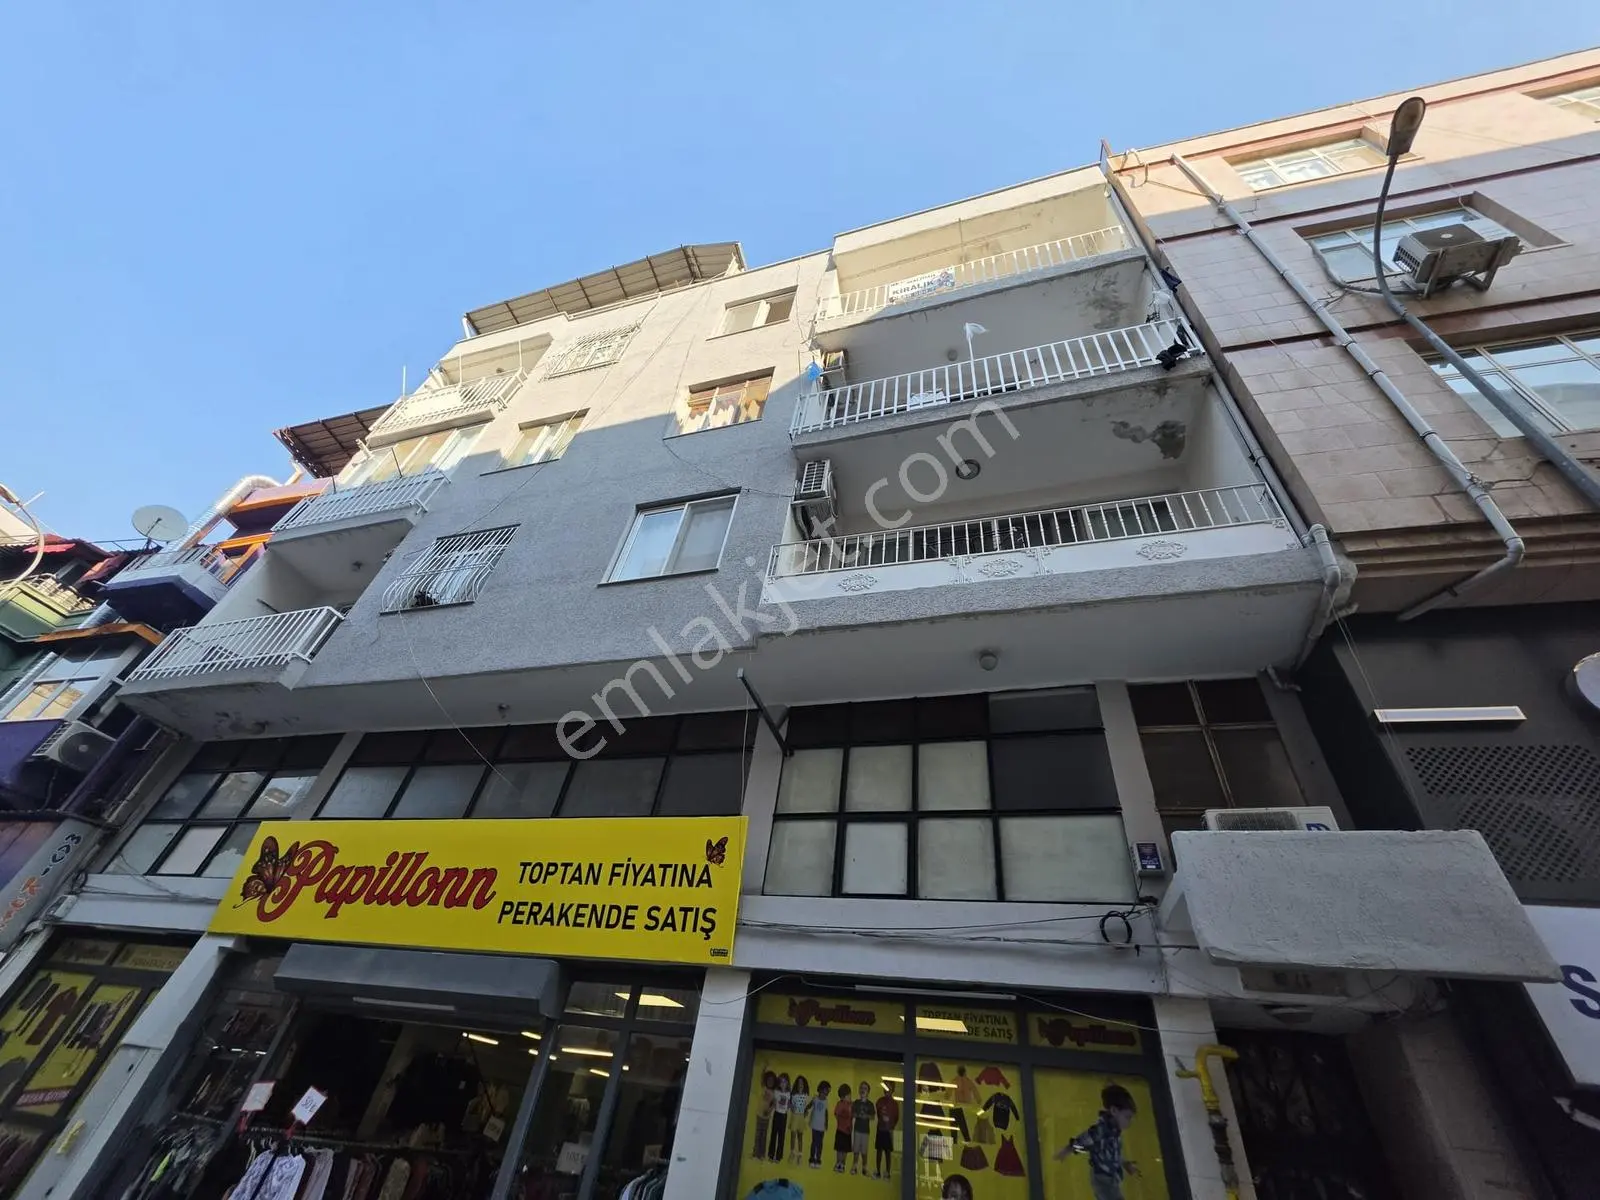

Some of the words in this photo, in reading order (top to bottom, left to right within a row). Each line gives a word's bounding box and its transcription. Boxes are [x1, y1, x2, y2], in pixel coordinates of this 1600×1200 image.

[256, 840, 498, 923] Papillonn
[519, 861, 603, 886] TOPTAN
[608, 857, 713, 888] FİYATINA
[497, 900, 639, 930] PERAKENDE
[644, 906, 718, 941] SATIŞ
[983, 1026, 1014, 1042] SATIŞ
